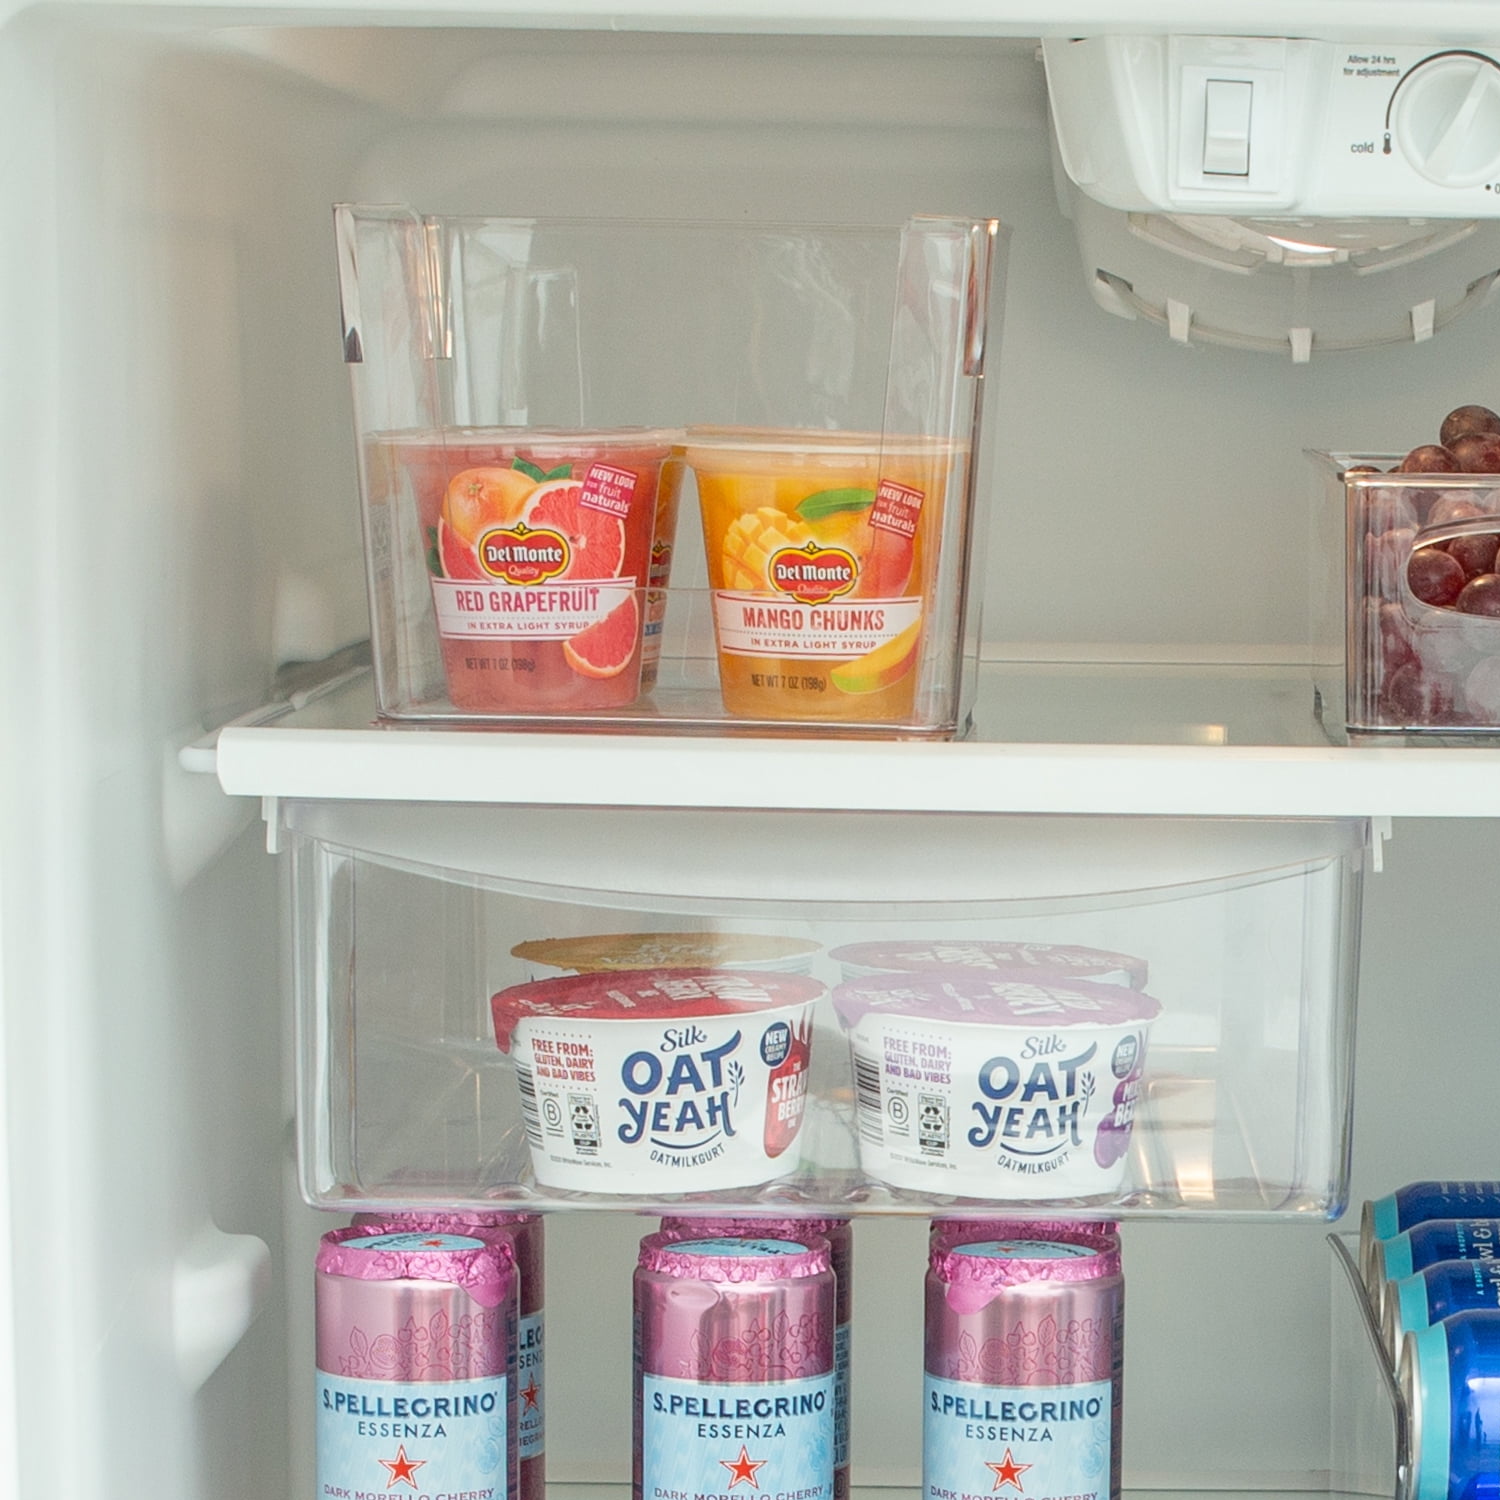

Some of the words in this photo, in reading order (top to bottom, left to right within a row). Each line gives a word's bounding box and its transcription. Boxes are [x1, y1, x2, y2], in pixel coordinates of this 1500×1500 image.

[1347, 55, 1369, 65] Allow
[1371, 55, 1382, 65] 24
[1383, 56, 1396, 65] hrs
[1355, 67, 1400, 77] adjustment
[1351, 142, 1374, 153] cold
[589, 467, 615, 483] NEW
[613, 472, 636, 489] LOOK
[580, 489, 630, 514] naturals
[871, 510, 915, 533] naturals
[486, 545, 510, 563] Del
[512, 545, 563, 562] Monte
[508, 564, 540, 578] Quality
[776, 564, 800, 580] Del
[802, 565, 850, 580] Monte
[456, 590, 484, 612] RED
[489, 586, 600, 612] GRAPEFRUIT
[480, 622, 513, 631] EXTRA
[517, 622, 549, 630] LIGHT
[555, 621, 590, 630] SYRUP
[743, 607, 804, 631] MANGO
[809, 608, 885, 631] CHUNKS
[763, 639, 799, 648] EXTRA
[803, 640, 837, 649] LIGHT
[842, 640, 877, 649] SYRUP
[532, 1037, 554, 1052] FREE
[556, 1040, 593, 1056] FROM:
[660, 1026, 704, 1052] Silk
[764, 1028, 788, 1046] NEW
[1021, 1034, 1064, 1059] Silk
[883, 1036, 909, 1051] FREE
[912, 1041, 951, 1058] FROM:
[565, 1055, 594, 1070] DAIRY
[621, 1029, 742, 1095] OAT
[920, 1056, 951, 1071] DAIRY
[978, 1041, 1098, 1102] OAT
[549, 1068, 567, 1080] BAD
[569, 1070, 596, 1082] VIBES
[903, 1068, 922, 1081] BAD
[924, 1071, 951, 1084] VIBES
[617, 1091, 737, 1145] YEAH
[967, 1101, 1082, 1147] YEAH
[649, 1142, 725, 1168] OATMILKGURT
[997, 1151, 1070, 1174] OATMILKGURT
[322, 1389, 497, 1419] S.PELLEGRINO
[653, 1391, 826, 1419] S.PELLEGRINO
[931, 1391, 1102, 1422] S.PELLEGRINO
[358, 1421, 447, 1438] ESSENZA
[698, 1423, 786, 1439] ESSENZA
[966, 1424, 1053, 1442] ESSENZA
[324, 1484, 351, 1500] DARK
